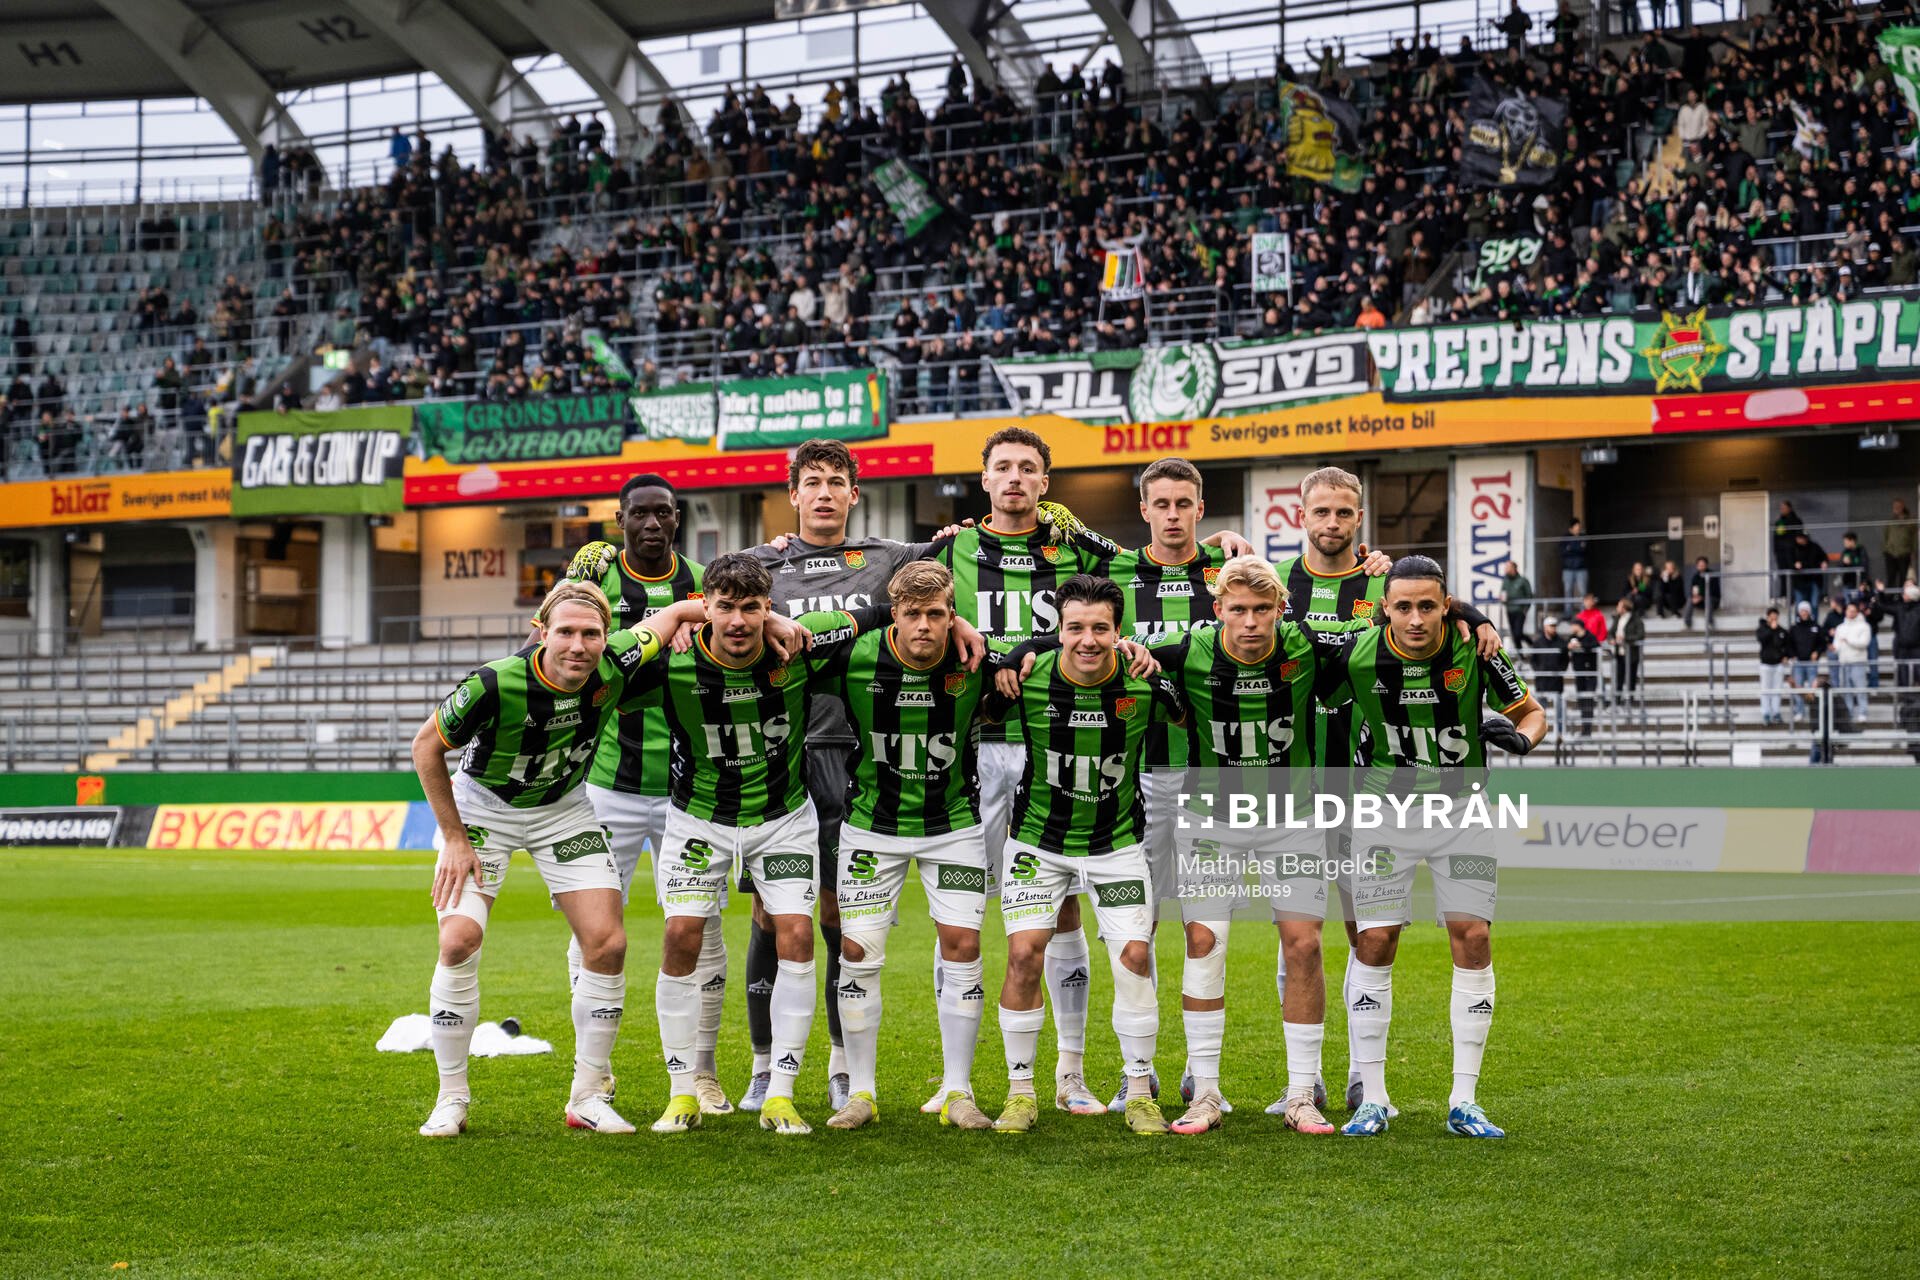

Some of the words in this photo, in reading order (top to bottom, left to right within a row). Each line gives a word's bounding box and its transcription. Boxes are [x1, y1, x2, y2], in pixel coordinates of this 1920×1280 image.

[299, 15, 371, 45] H2
[18, 42, 82, 66] H1
[1367, 320, 1635, 393] PREPPENS
[1726, 299, 1920, 380] STÅPL
[1222, 345, 1355, 398] GAIS
[824, 385, 844, 408] to
[849, 382, 863, 406] it
[466, 394, 625, 430] GRÖNSVART
[848, 406, 861, 425] it
[1103, 421, 1193, 454] bilar
[1210, 422, 1289, 443] Sveriges
[1295, 419, 1342, 435] mest
[1347, 415, 1404, 436] köpta
[1411, 411, 1435, 430] bil
[463, 425, 622, 462] GÖTEBORG
[51, 484, 112, 516] bilar
[122, 491, 174, 508] Sveriges
[177, 489, 208, 503] mest
[211, 487, 231, 502] köp
[1265, 485, 1302, 562] T21
[1470, 470, 1511, 604] FAT21
[444, 548, 507, 579] FAT21
[806, 560, 837, 569] SKAB
[1001, 556, 1034, 567] SKAB
[1159, 583, 1191, 593] SKAB
[975, 589, 1061, 633] ITS
[724, 688, 760, 698] SKAB
[1235, 680, 1269, 690] SKAB
[1402, 690, 1435, 699] SKAB
[898, 692, 932, 702] SKAB
[547, 713, 579, 726] SKAB
[1072, 712, 1105, 722] SKAB
[701, 711, 791, 759] ITS
[1208, 714, 1295, 757] ITS
[1382, 723, 1470, 764] ITS
[868, 731, 957, 771] ITS
[1044, 748, 1129, 793] ITS
[1227, 756, 1281, 767] indeship.se
[889, 767, 940, 781] indeship.se
[1061, 788, 1110, 803] indeship.se
[0, 819, 113, 841] YDROSCAND
[153, 809, 395, 851] BYGGMAX
[1556, 813, 1698, 848] weber
[769, 860, 809, 874] AVIX
[1455, 862, 1494, 876] AVIX
[943, 872, 983, 886] AVIX
[839, 891, 851, 903] Åke
[854, 888, 892, 902] Ekstrand
[1015, 890, 1053, 902] Ekstrand
[1355, 887, 1369, 900] Åke
[839, 904, 882, 921] yggnads
[1003, 905, 1043, 921] yggnads
